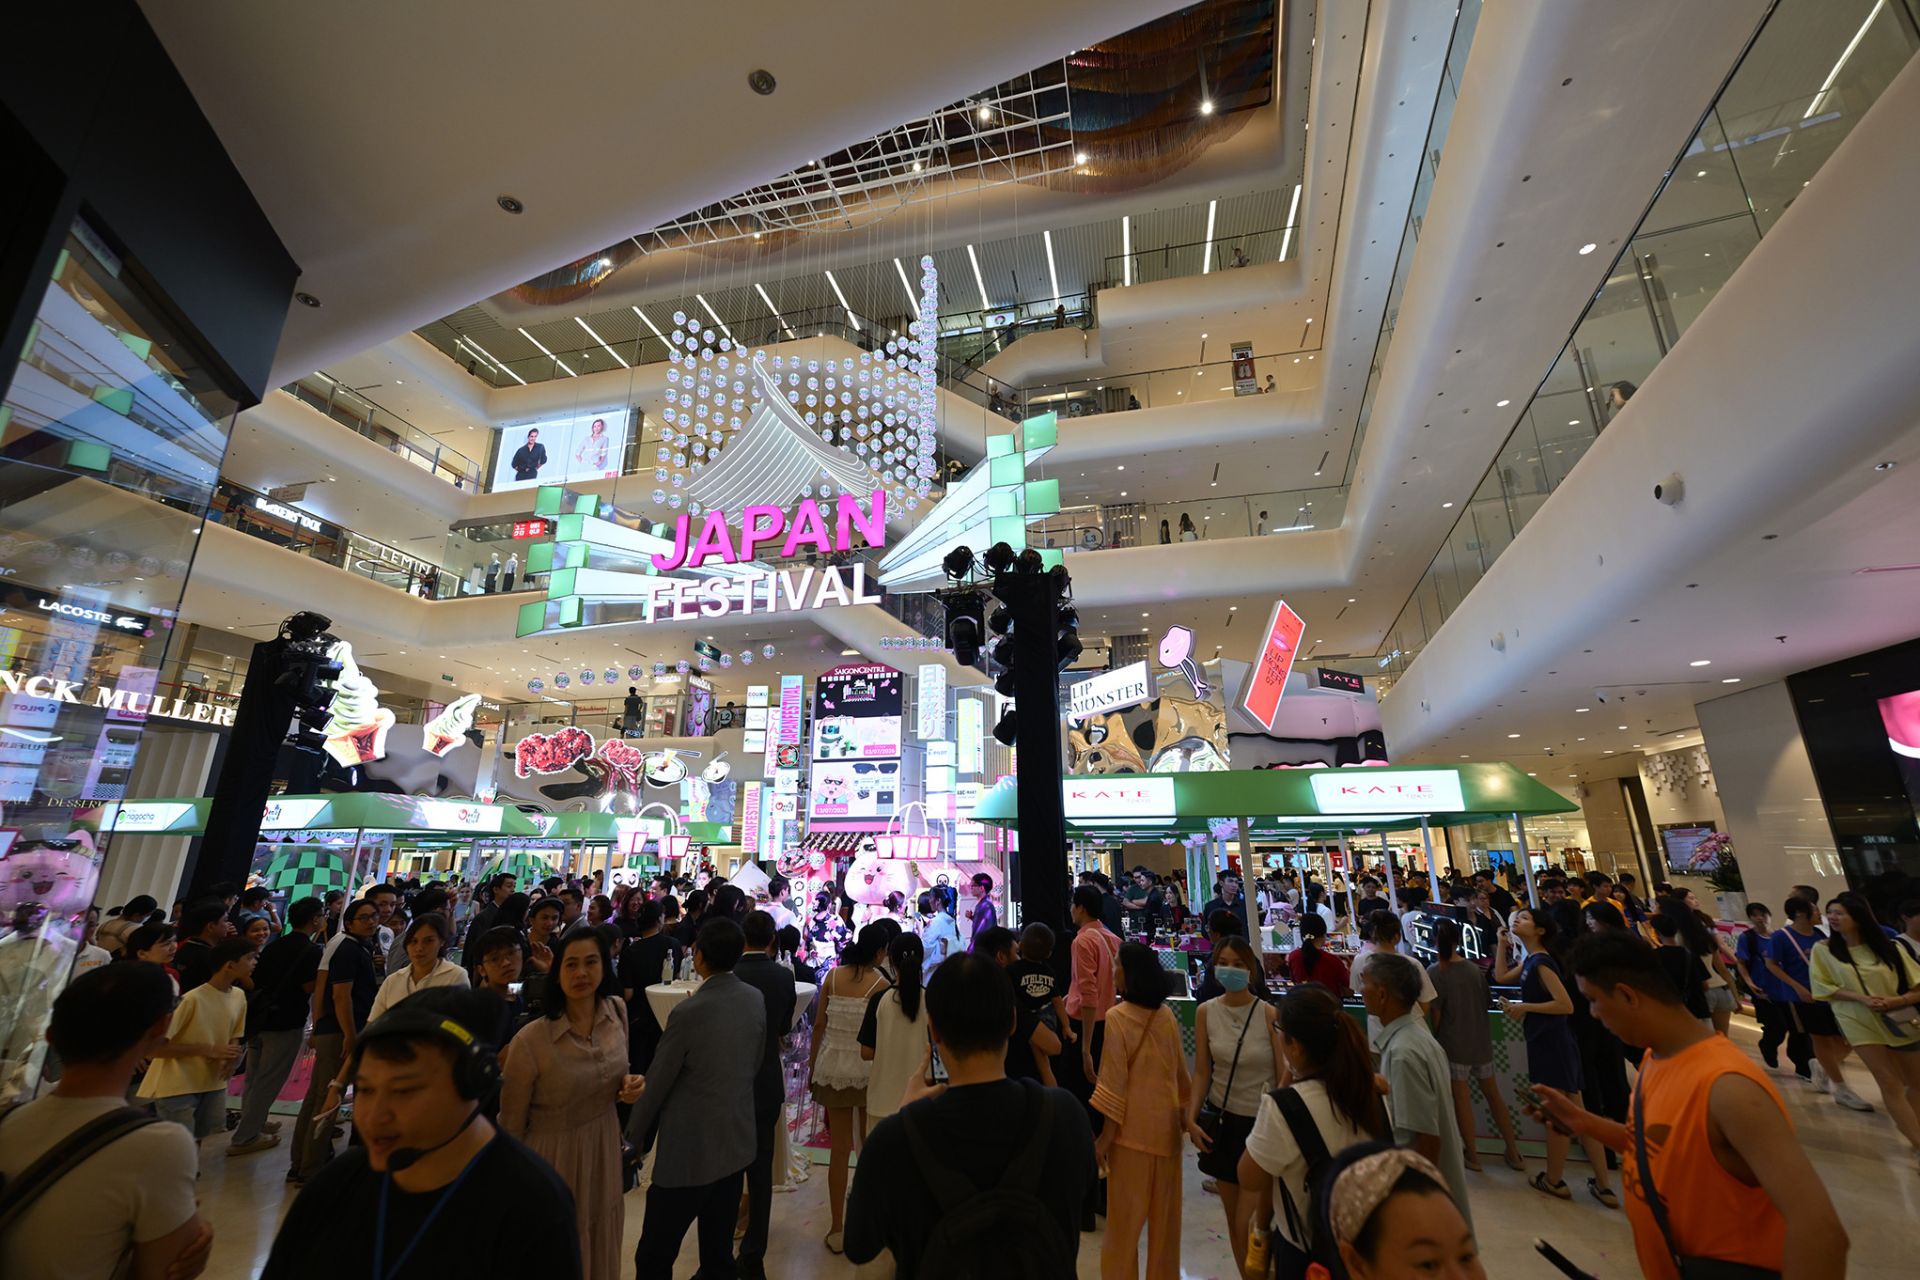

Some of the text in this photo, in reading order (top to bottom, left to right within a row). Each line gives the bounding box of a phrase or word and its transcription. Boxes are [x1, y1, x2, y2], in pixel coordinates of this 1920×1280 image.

[651, 489, 887, 571] JAPAN
[646, 562, 882, 624] FESTIVAL
[38, 599, 113, 624] LACOSTE
[1322, 672, 1361, 684] KATE
[1072, 681, 1094, 699] LIP
[1072, 682, 1145, 715] MONSTER
[94, 686, 236, 728] MULLER
[720, 712, 731, 720] L2
[1072, 790, 1152, 798] KATE
[1342, 784, 1433, 794] KATE
